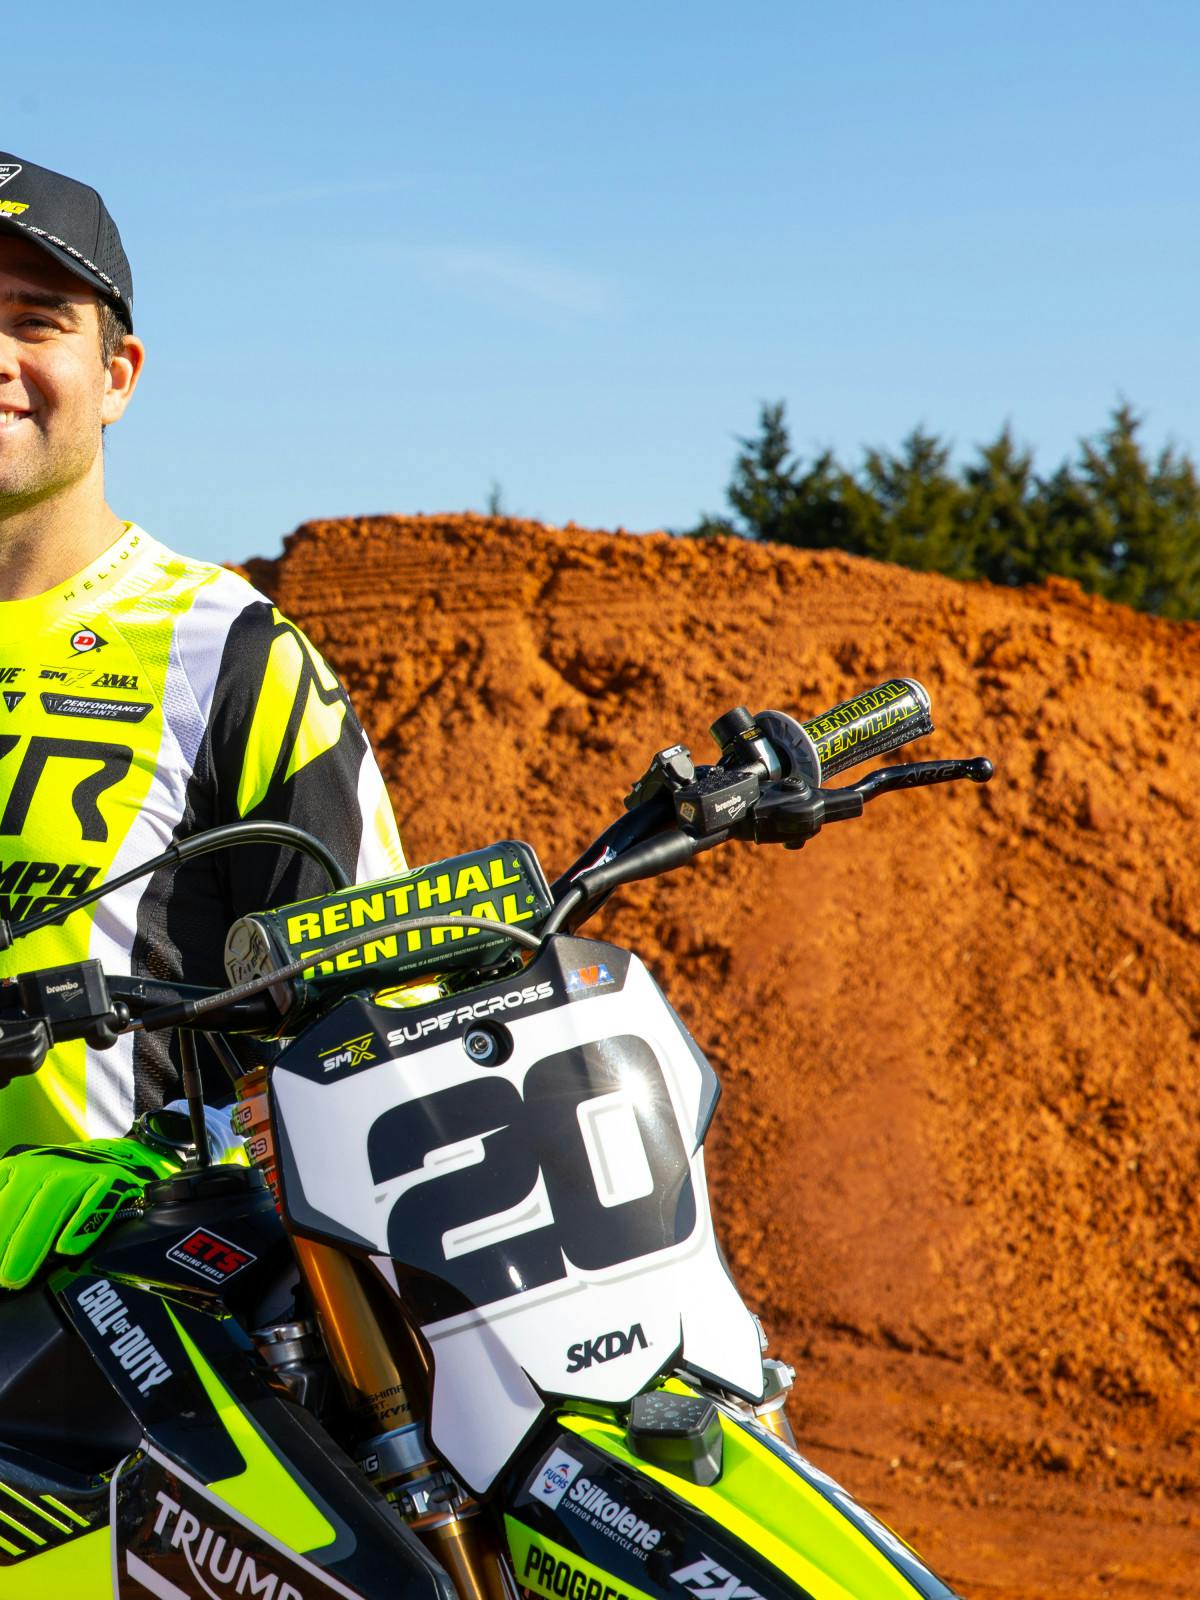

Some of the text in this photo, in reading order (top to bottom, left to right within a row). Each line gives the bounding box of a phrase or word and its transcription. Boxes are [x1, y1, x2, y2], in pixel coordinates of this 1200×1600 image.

[63, 536, 140, 601] HELIUM
[62, 699, 146, 713] PERFORMANCE
[91, 673, 138, 691] AMA
[57, 705, 118, 717] LUBRICANTS
[804, 683, 909, 741] RENTHAL
[816, 702, 920, 763] RENTHAL
[714, 795, 742, 813] brembo
[287, 857, 521, 946] RENTHAL
[46, 981, 79, 995] brembo
[565, 963, 615, 993] AMA
[323, 980, 555, 1073] SMX SUPERCROSS
[367, 1034, 697, 1327] 20
[172, 1249, 225, 1280] RACING FUELS
[181, 1233, 249, 1273] ETS
[76, 1279, 174, 1398] CALL OF DUTY
[566, 1322, 648, 1374] SKDA
[543, 1468, 569, 1490] FUCHS
[561, 1498, 649, 1562] SUPERIOR MOTORCYCLE OILS
[569, 1477, 662, 1550] Silkolene
